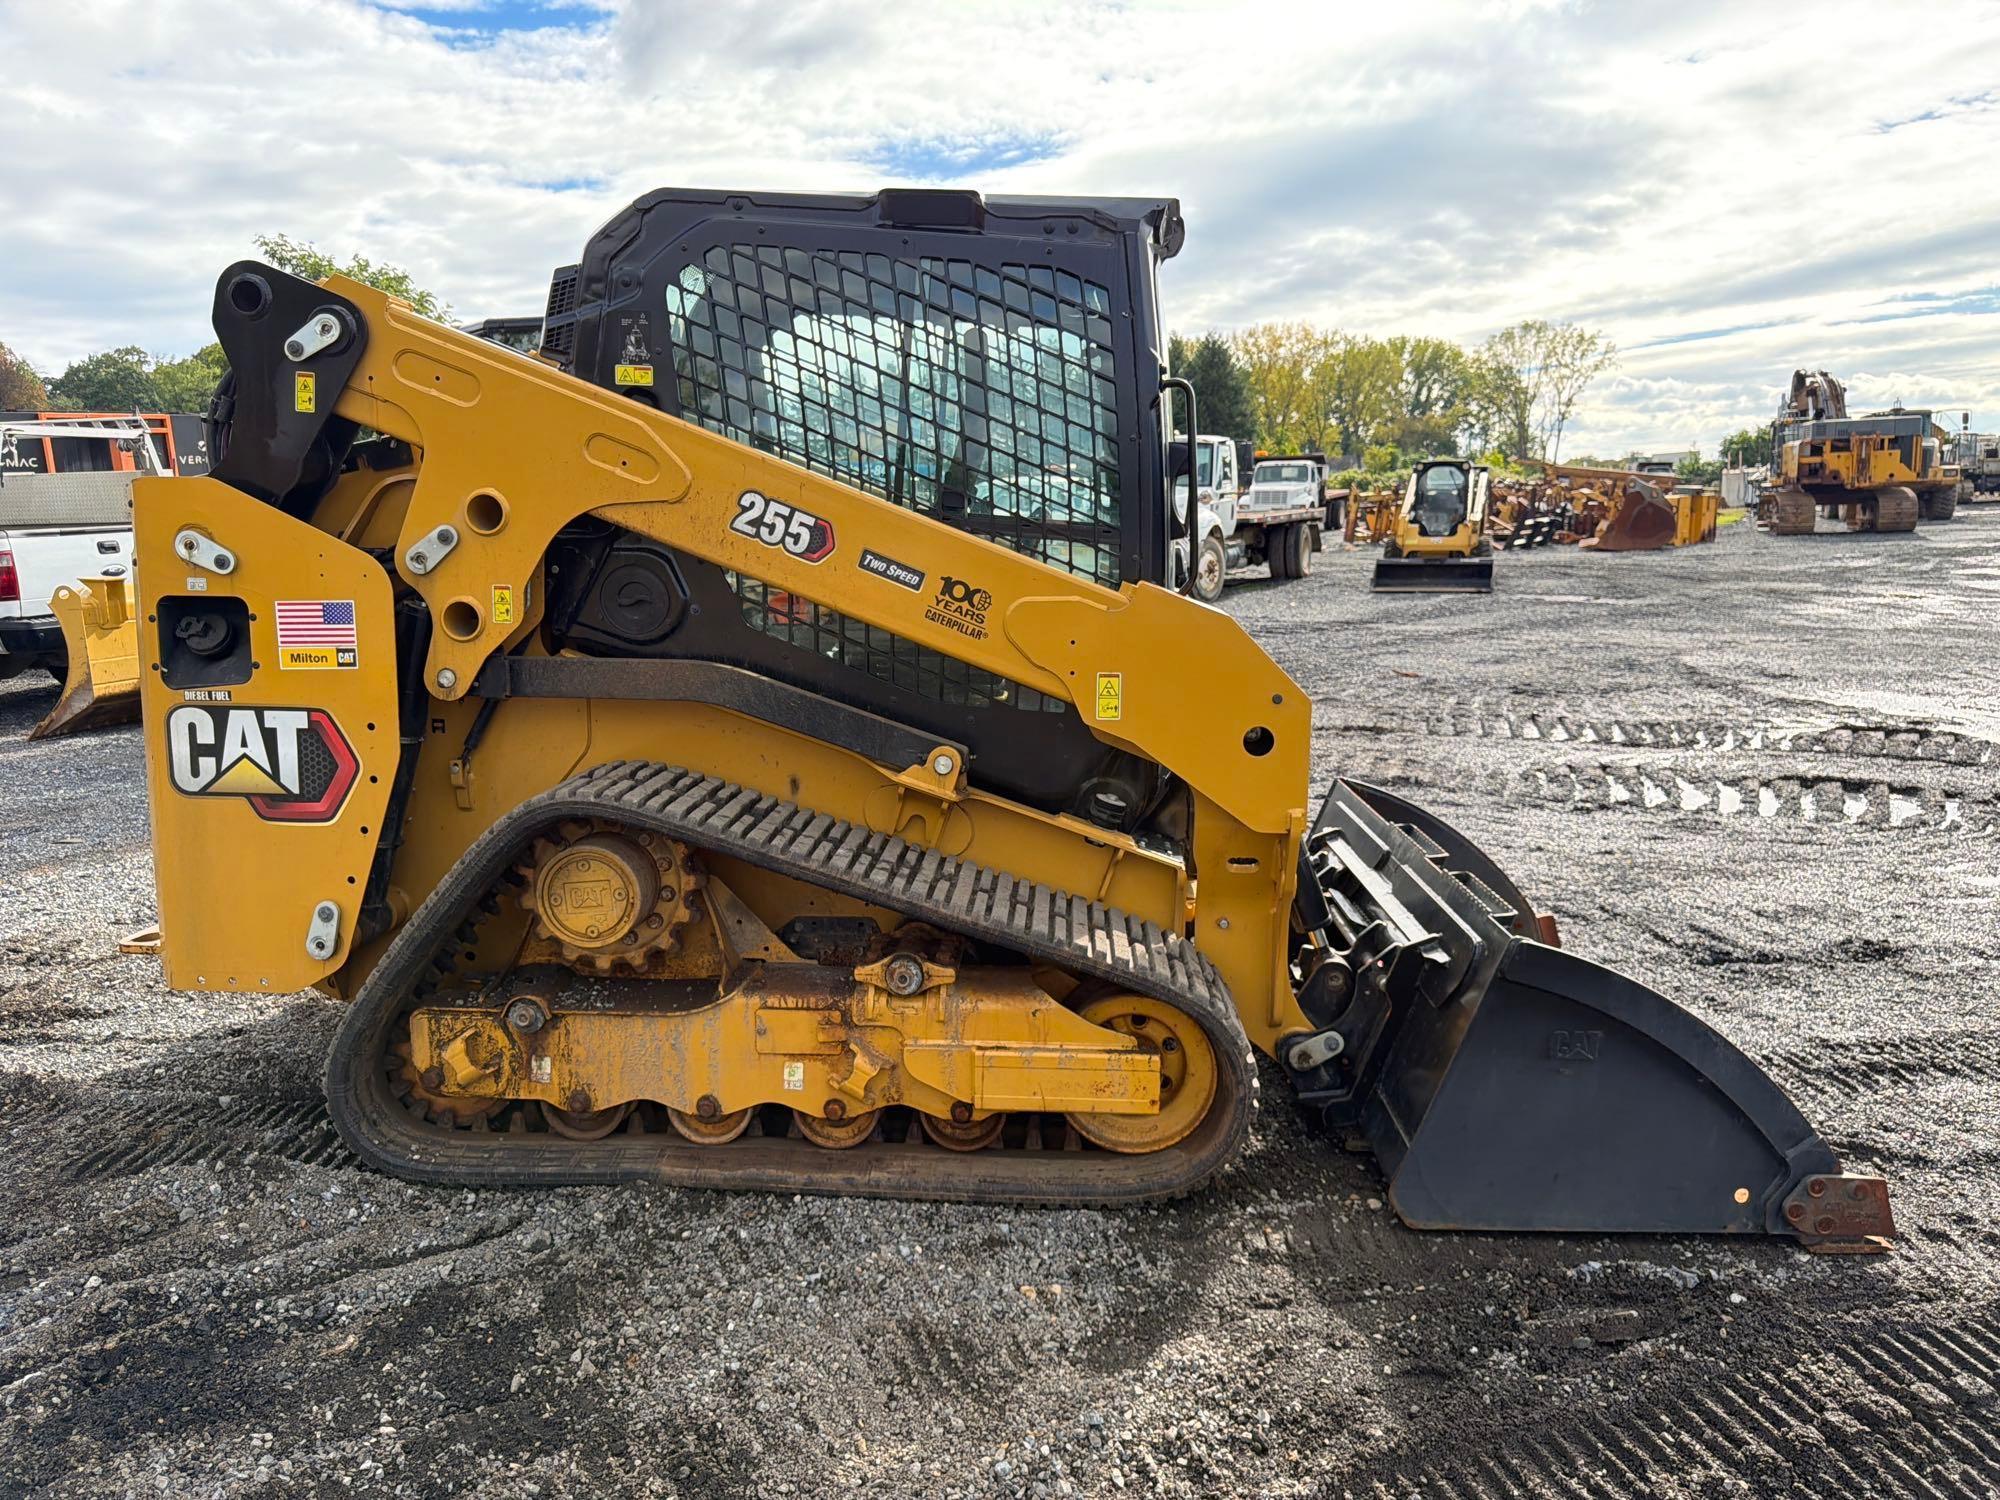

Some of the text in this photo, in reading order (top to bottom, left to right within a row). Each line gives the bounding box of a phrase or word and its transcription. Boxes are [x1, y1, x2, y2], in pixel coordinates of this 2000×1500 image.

[732, 491, 816, 554] 255
[940, 576, 992, 612] 100
[934, 595, 986, 625] YEARS
[290, 652, 355, 664] Milton CAT
[184, 690, 230, 701] DIESEL FUEL
[169, 706, 309, 795] CAT
[569, 886, 608, 909] CAT
[1552, 1029, 1604, 1061] CAT
